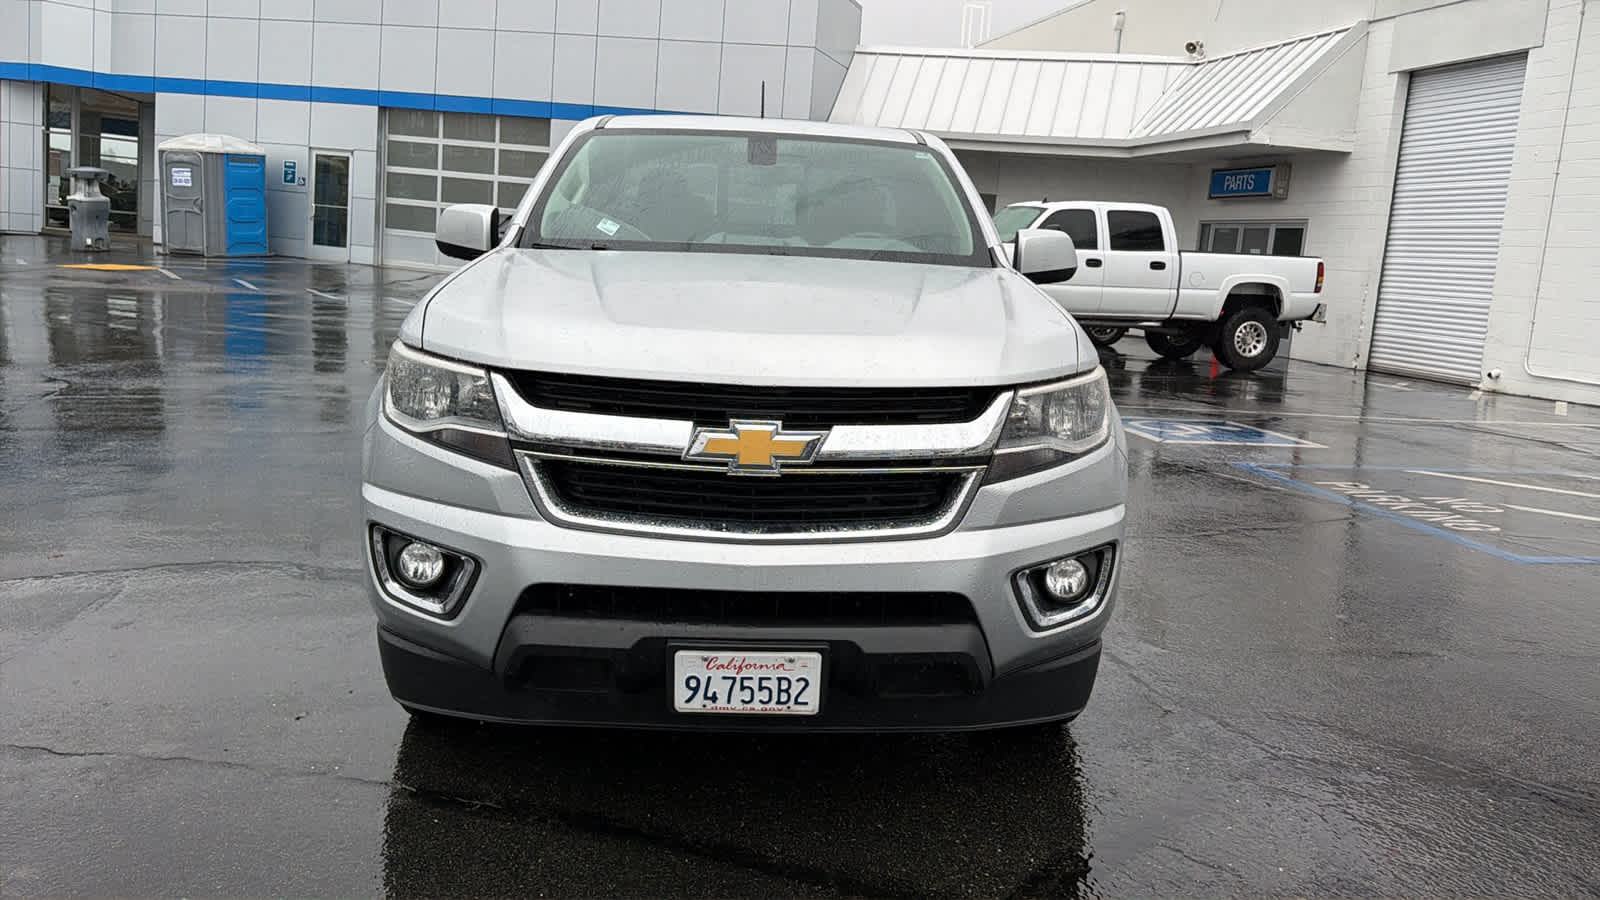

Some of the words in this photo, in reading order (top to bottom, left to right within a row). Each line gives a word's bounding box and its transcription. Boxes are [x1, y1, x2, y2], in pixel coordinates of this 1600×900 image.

[1223, 174, 1256, 191] PARTS
[1313, 481, 1501, 532] PARKING
[1418, 496, 1505, 513] NO
[706, 656, 795, 675] California
[684, 675, 810, 706] 94755B2
